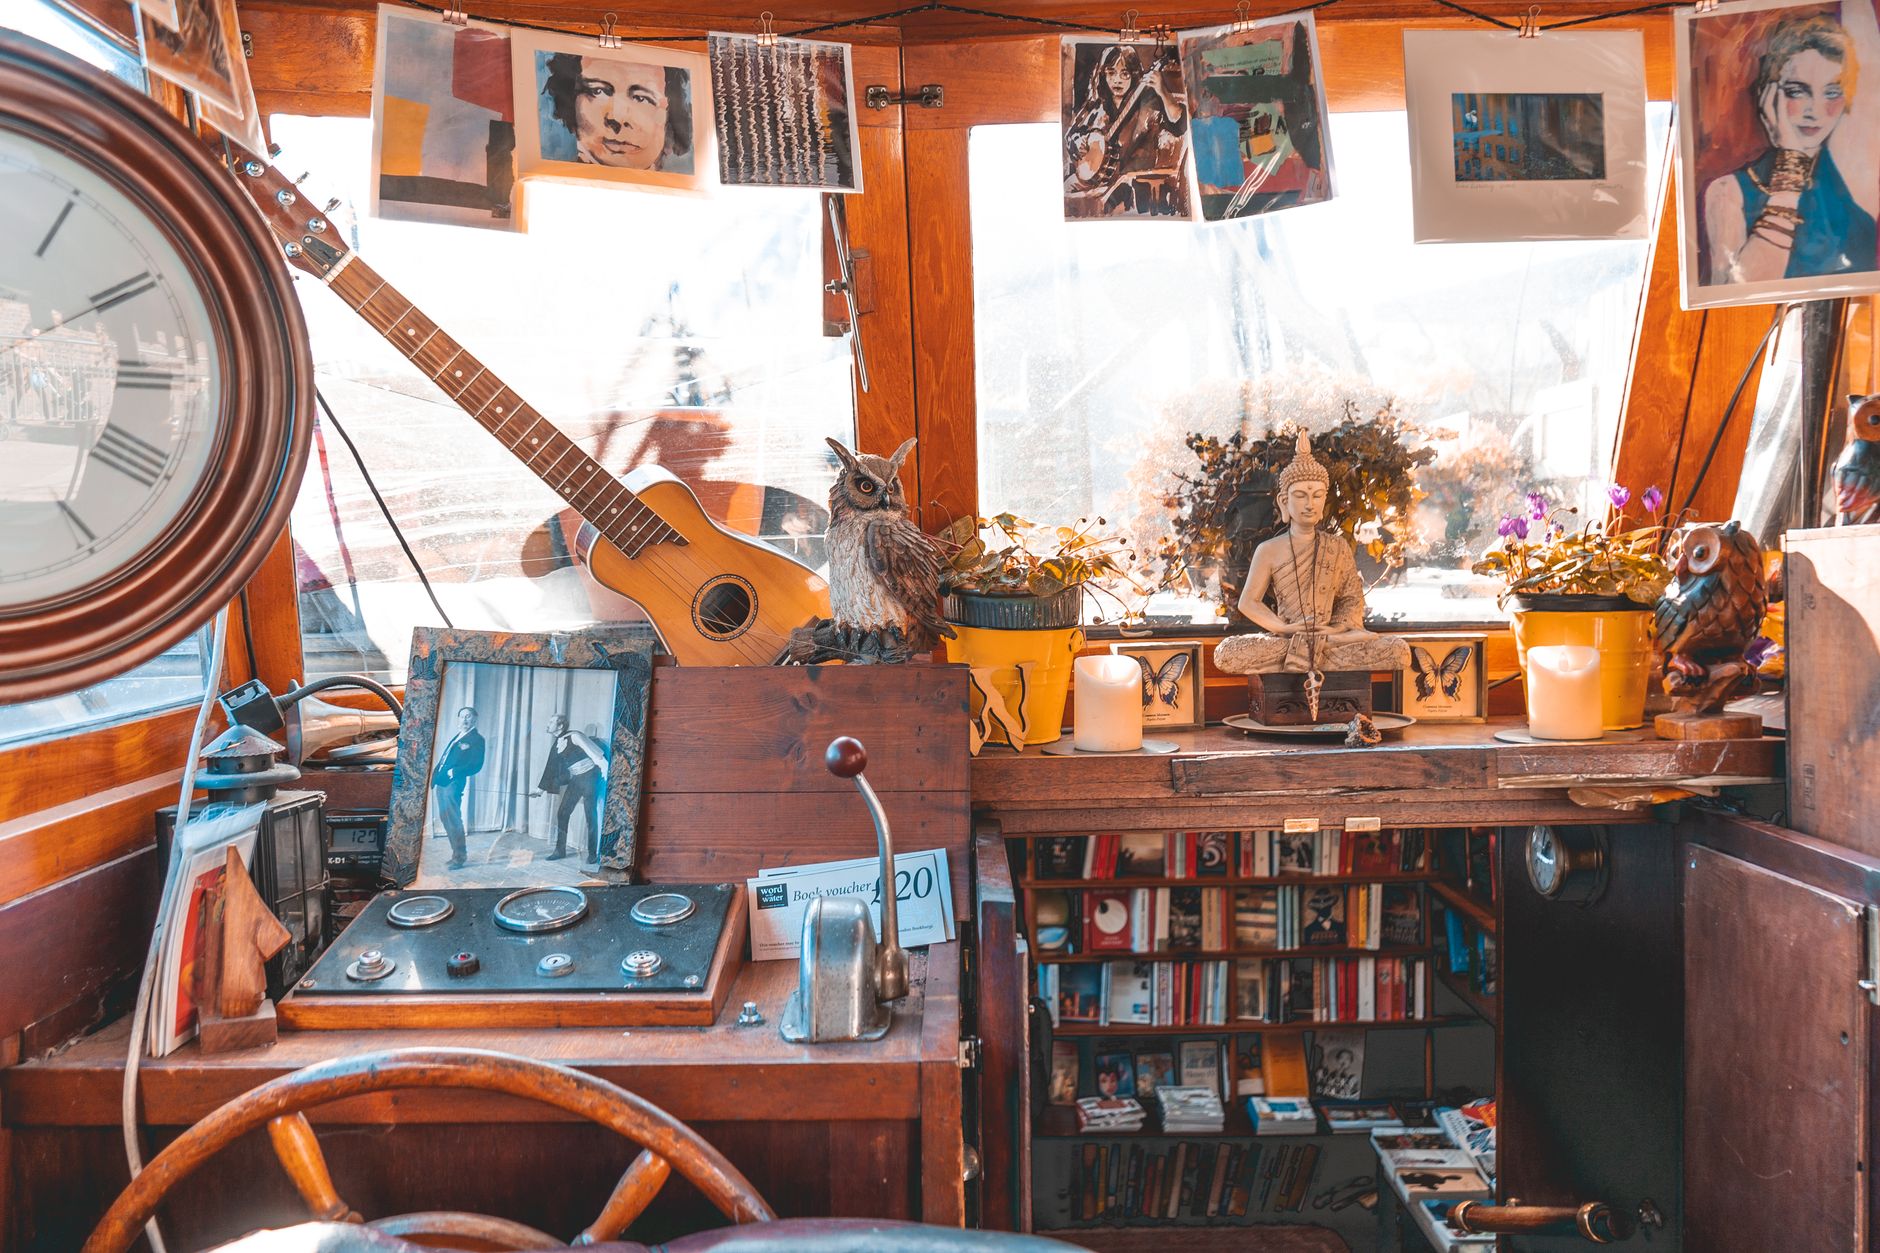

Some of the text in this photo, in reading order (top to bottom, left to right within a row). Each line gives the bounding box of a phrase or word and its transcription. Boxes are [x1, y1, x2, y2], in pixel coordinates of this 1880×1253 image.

[760, 884, 783, 895] word
[826, 881, 871, 897] voucher
[762, 895, 784, 903] water
